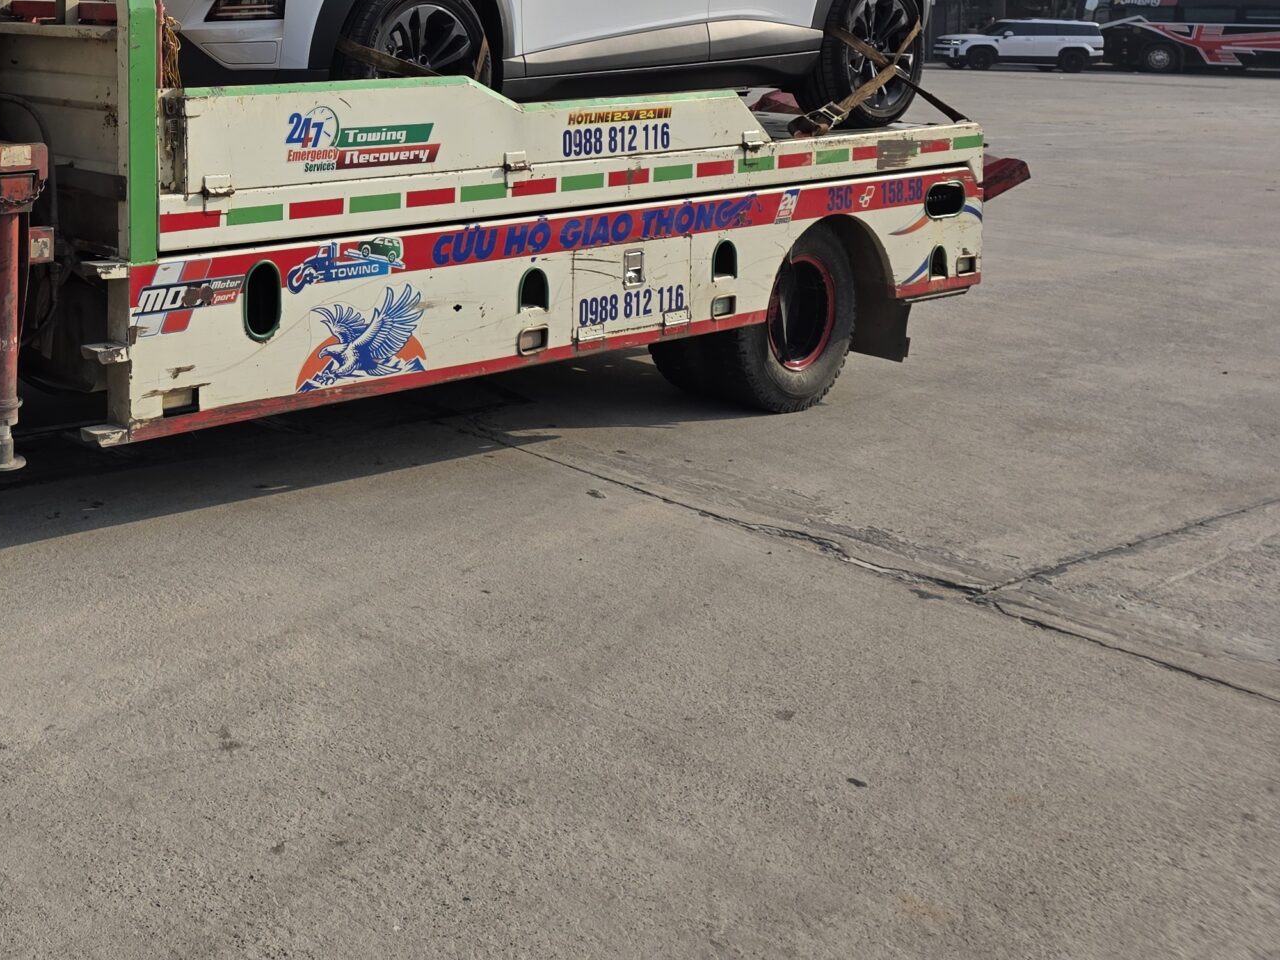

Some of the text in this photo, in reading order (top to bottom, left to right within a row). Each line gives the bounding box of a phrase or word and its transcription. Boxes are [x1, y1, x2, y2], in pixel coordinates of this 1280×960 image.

[567, 111, 612, 126] HOTLINE
[344, 128, 407, 144] Towing
[563, 122, 670, 158] 0988 812 116
[287, 149, 340, 162] Emergency
[344, 148, 430, 166] Recovery
[304, 161, 336, 173] Services
[826, 177, 924, 212] 35C 158.58
[432, 223, 498, 266] CỨU
[559, 210, 633, 250] GIAO
[640, 198, 732, 240] THÔNG
[329, 264, 380, 279] TOWING
[211, 277, 242, 290] Motor
[213, 290, 236, 304] port
[579, 284, 685, 326] 0988 812 116
